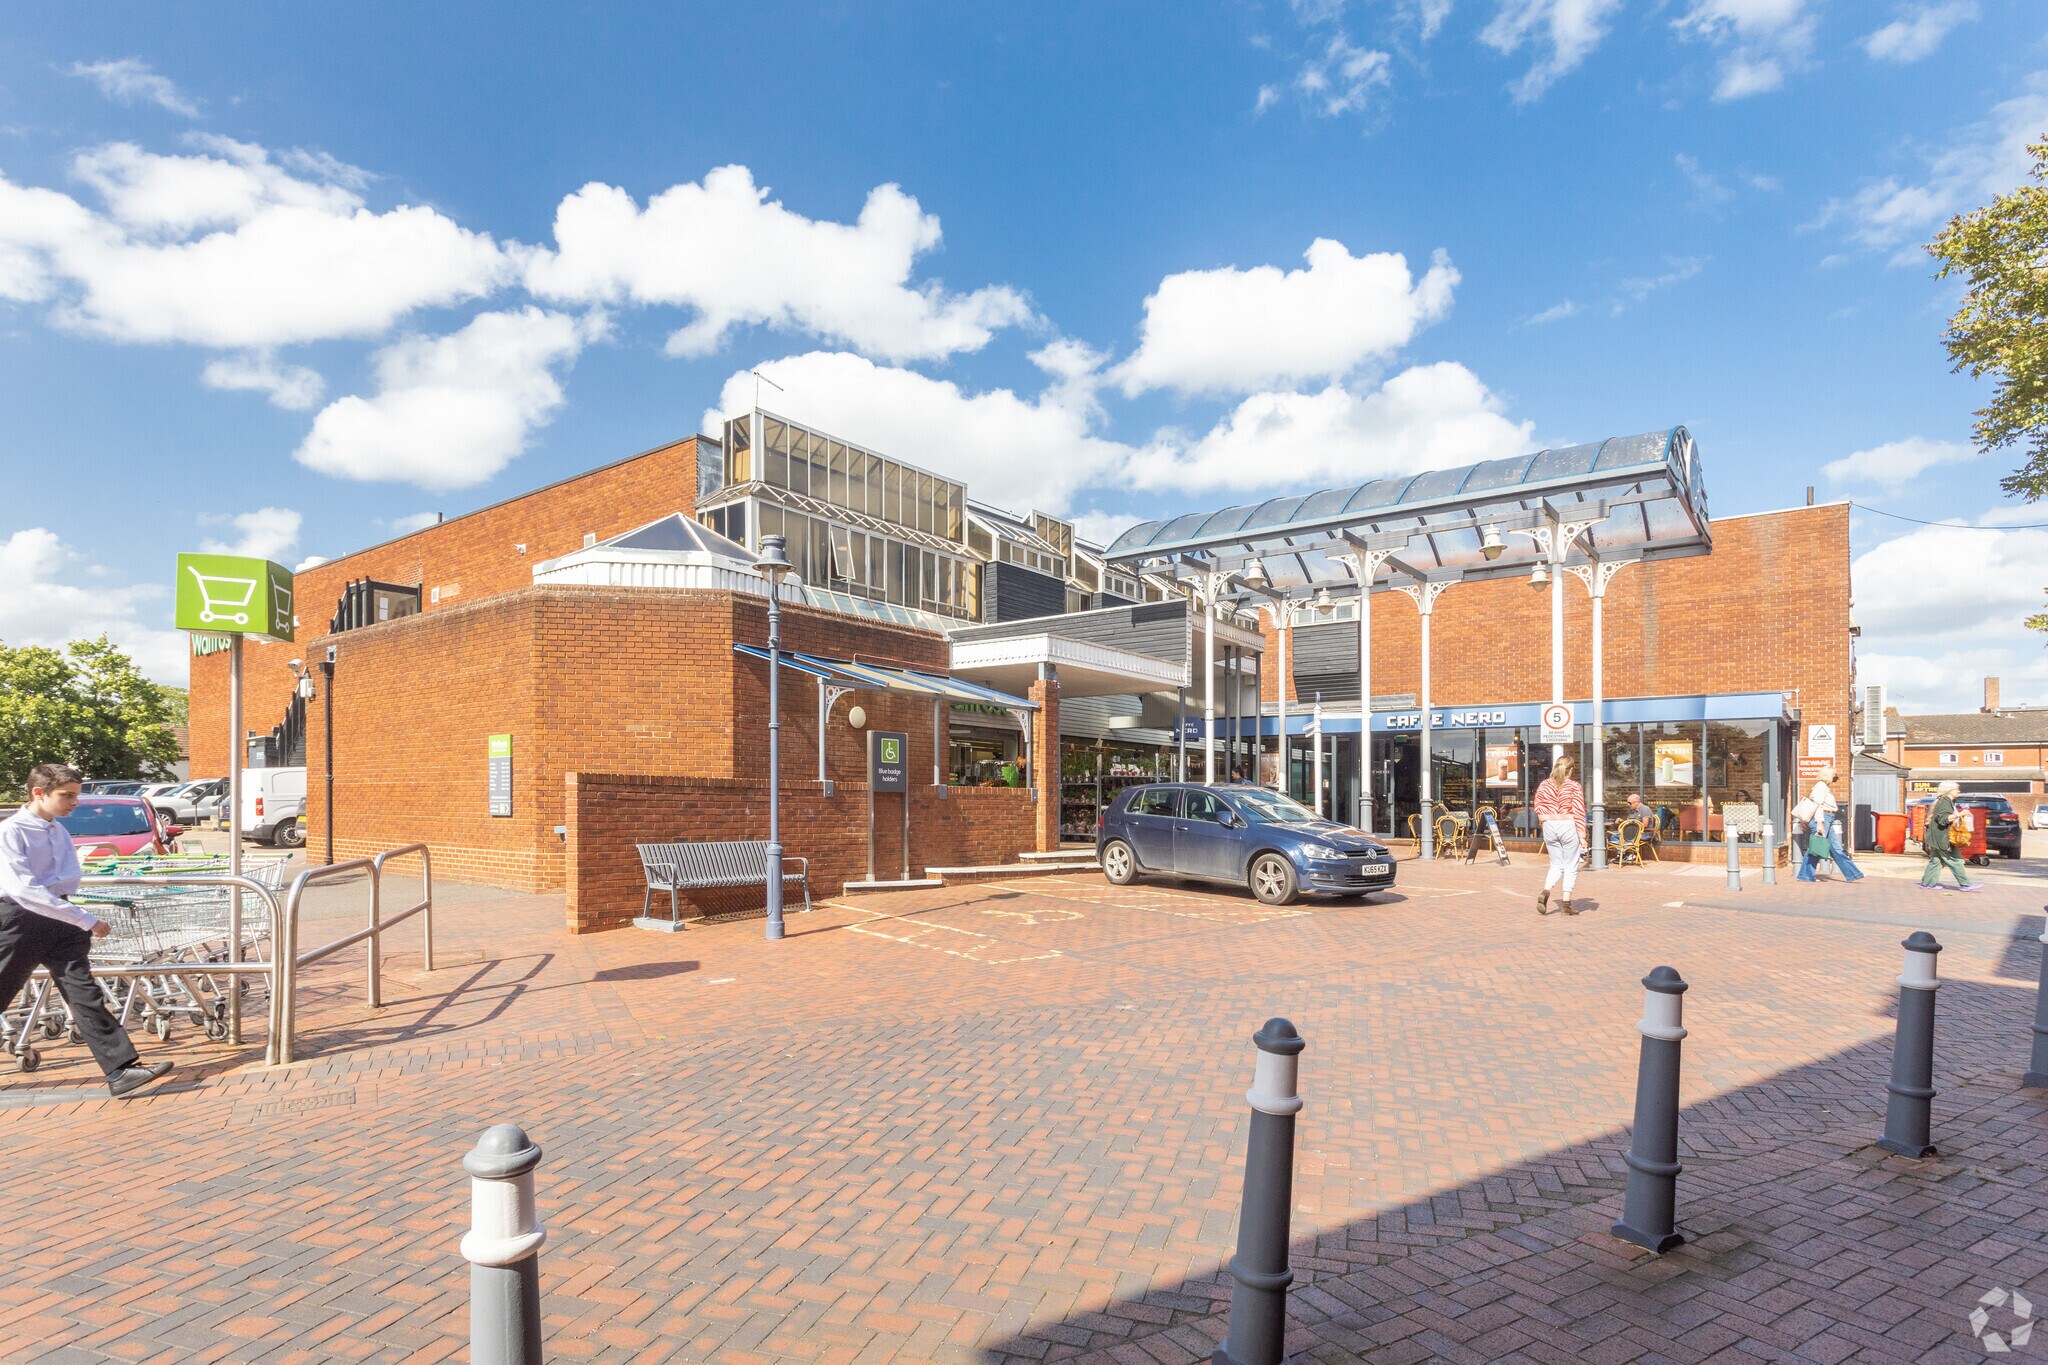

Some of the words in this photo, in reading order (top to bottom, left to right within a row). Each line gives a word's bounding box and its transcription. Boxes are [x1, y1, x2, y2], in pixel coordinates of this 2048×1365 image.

[191, 633, 232, 657] Waitros
[1386, 713, 1444, 728] CAFE
[1451, 711, 1507, 726] NERO
[1553, 712, 1562, 723] 5
[878, 767, 887, 775] Blue
[887, 768, 902, 776] badge
